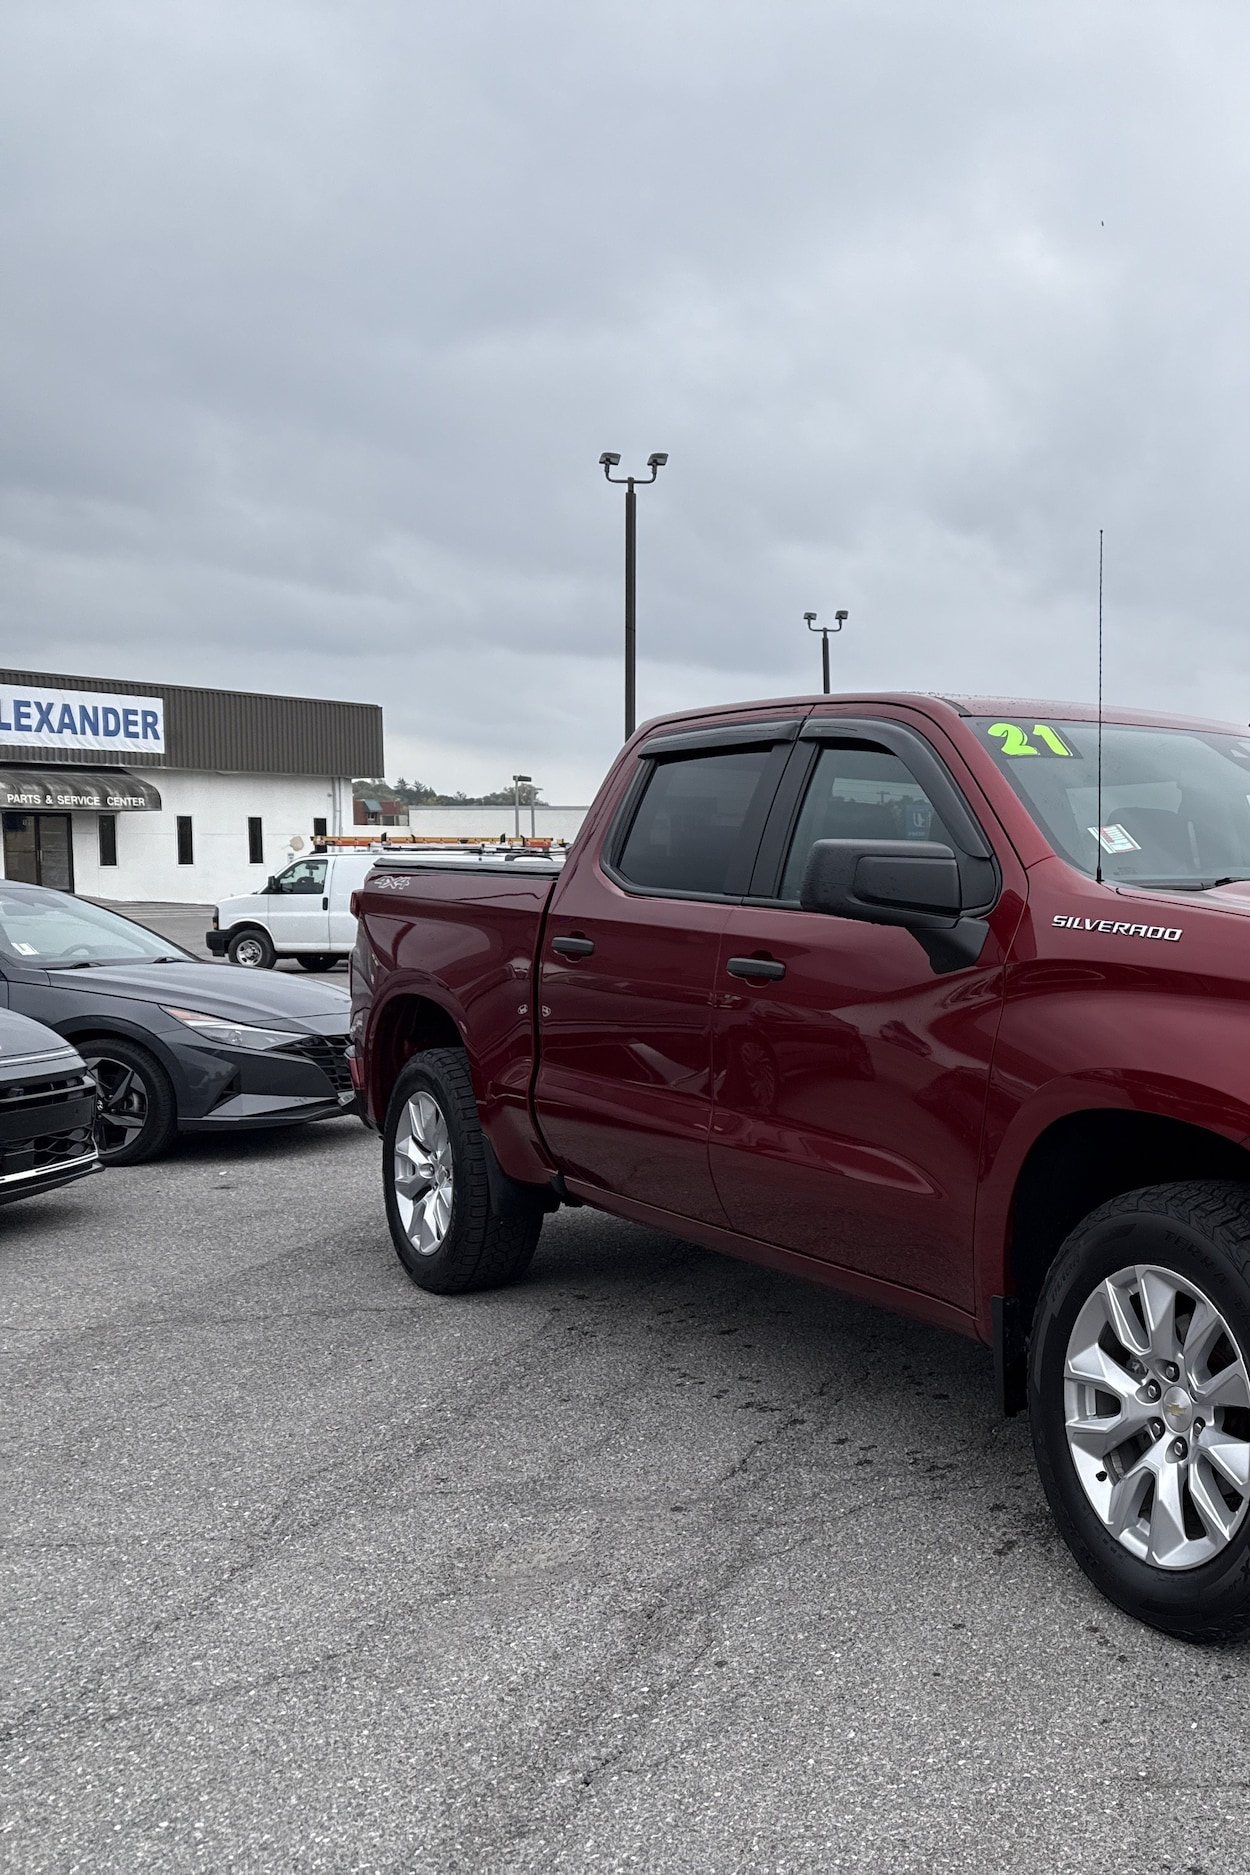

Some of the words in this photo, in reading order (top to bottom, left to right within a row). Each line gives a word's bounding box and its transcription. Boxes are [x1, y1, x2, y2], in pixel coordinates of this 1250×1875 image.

[0, 698, 161, 741] LEXANDER
[987, 723, 1073, 756] 21
[7, 794, 41, 804] PARTS
[45, 795, 53, 805] &
[57, 795, 101, 806] SERVICE
[107, 797, 145, 807] CENTER
[1051, 915, 1183, 943] SILVERADO
